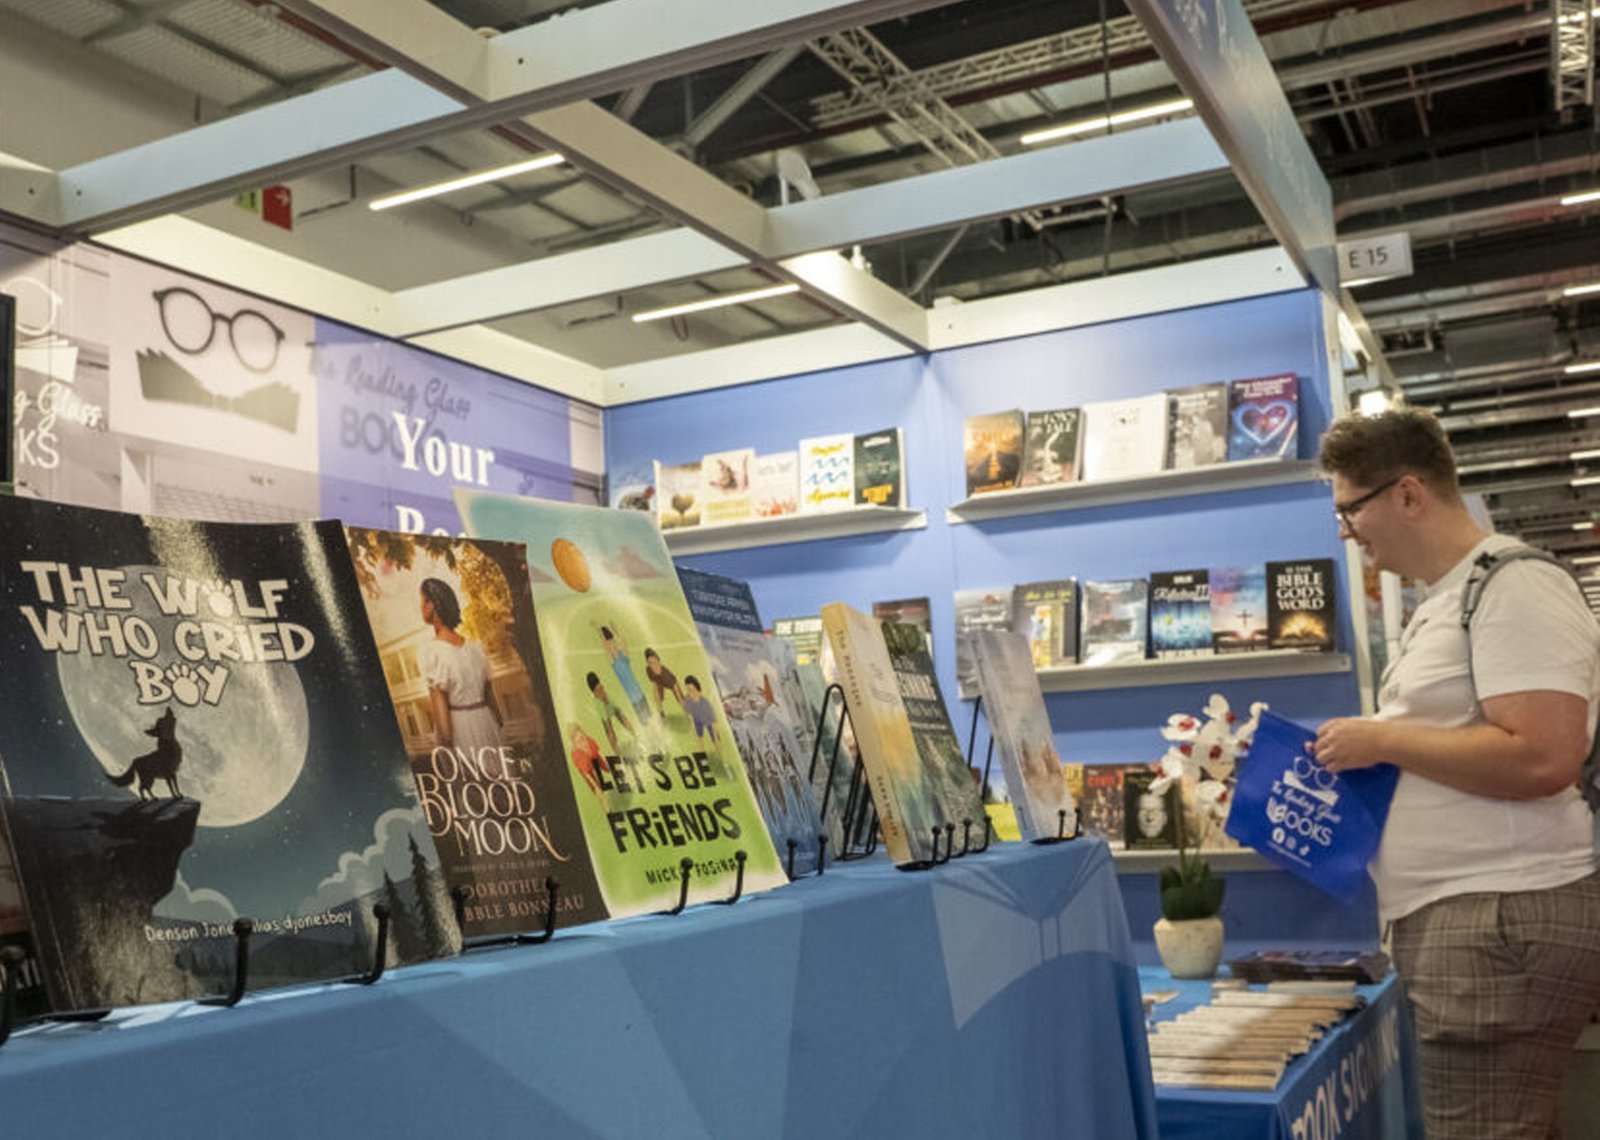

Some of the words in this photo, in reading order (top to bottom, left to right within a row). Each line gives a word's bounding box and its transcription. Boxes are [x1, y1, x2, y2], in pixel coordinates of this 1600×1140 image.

[1349, 250, 1362, 269] E
[1367, 246, 1388, 266] 15
[392, 411, 495, 486] Your
[20, 561, 132, 610] THE
[142, 573, 289, 618] WOLF
[1276, 571, 1323, 587] BIBLE
[1277, 598, 1325, 610] WORD
[19, 605, 159, 659] WHO
[174, 620, 316, 662] CRIED
[129, 660, 230, 707] BOY
[431, 746, 522, 782] ONCE
[592, 754, 673, 794] LETS
[674, 752, 717, 790] BE
[416, 773, 536, 836] BLOOD
[1273, 802, 1334, 847] BOOKS
[454, 816, 570, 861] MOON
[144, 923, 199, 942] Denson
[202, 921, 236, 938] Jone
[463, 903, 504, 922] BBLE
